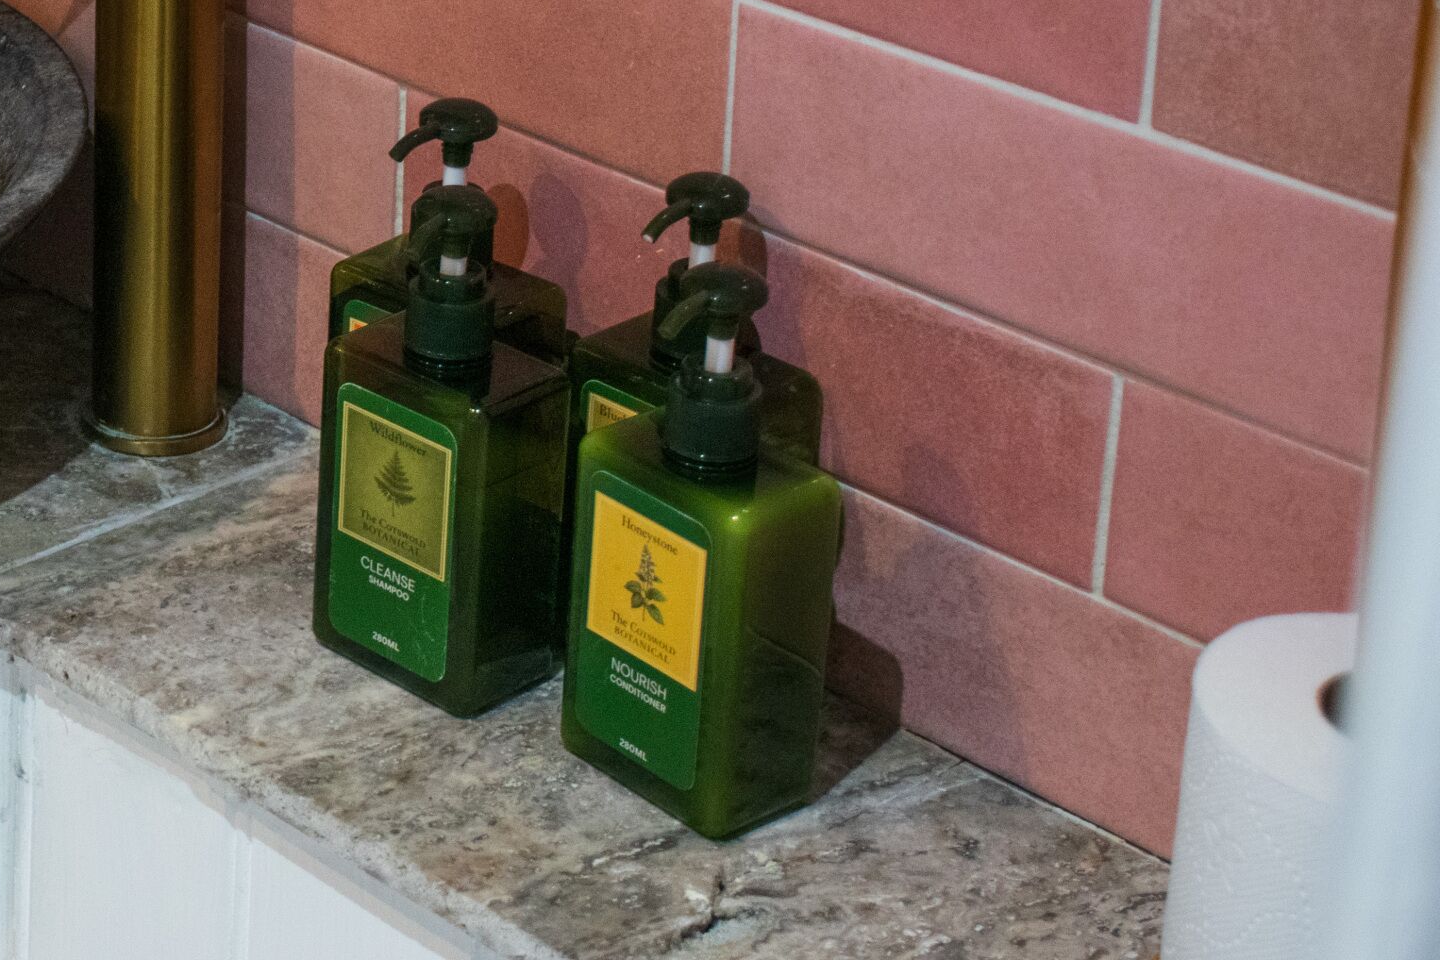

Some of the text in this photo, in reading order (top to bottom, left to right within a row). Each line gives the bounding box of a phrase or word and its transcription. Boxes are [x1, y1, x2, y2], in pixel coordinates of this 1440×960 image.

[369, 420, 427, 456] Wildflower
[361, 509, 377, 524] The
[362, 522, 420, 557] BOTANICAL
[621, 514, 678, 556] Honeystone
[360, 556, 416, 593] CLEANSE
[368, 574, 410, 602] SHAMPOO
[611, 609, 628, 627] The
[372, 631, 400, 652] 280ML
[614, 625, 671, 665] BOTANICAL
[609, 674, 667, 713] CONDITIONER
[610, 657, 667, 700] NOURISH
